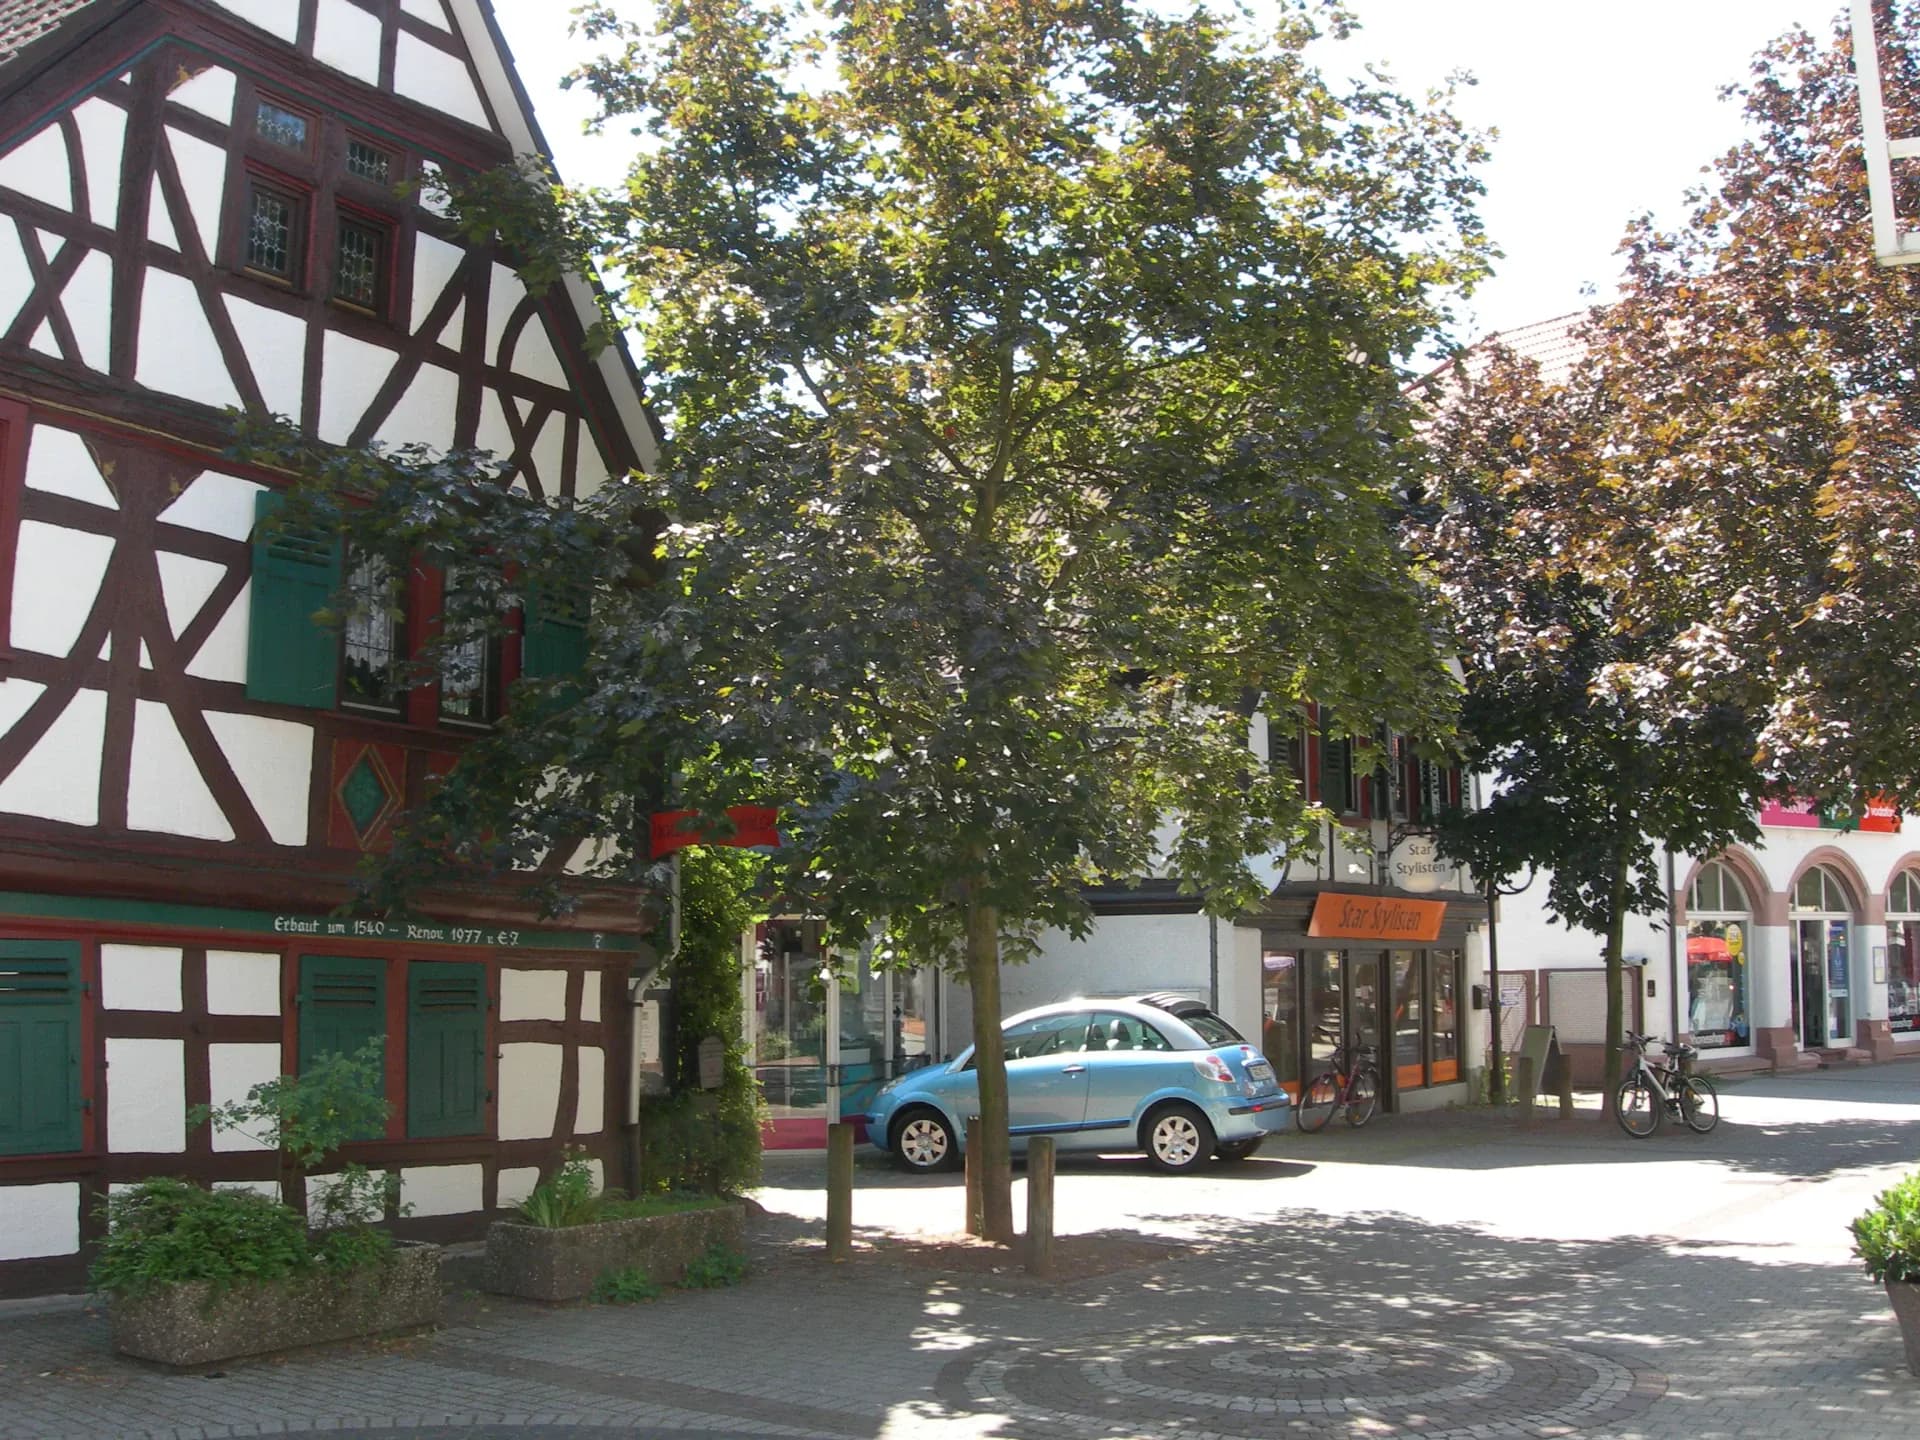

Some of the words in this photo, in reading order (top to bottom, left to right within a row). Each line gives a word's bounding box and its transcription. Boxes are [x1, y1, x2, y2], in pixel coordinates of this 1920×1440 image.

[1408, 843, 1432, 856] Star
[1396, 861, 1446, 876] Stylisten
[1339, 899, 1368, 929] Star
[1370, 901, 1421, 934] Stylisten
[274, 916, 320, 933] Erbaut
[327, 923, 346, 934] um
[353, 920, 385, 935] 1540
[451, 927, 483, 944] 1977
